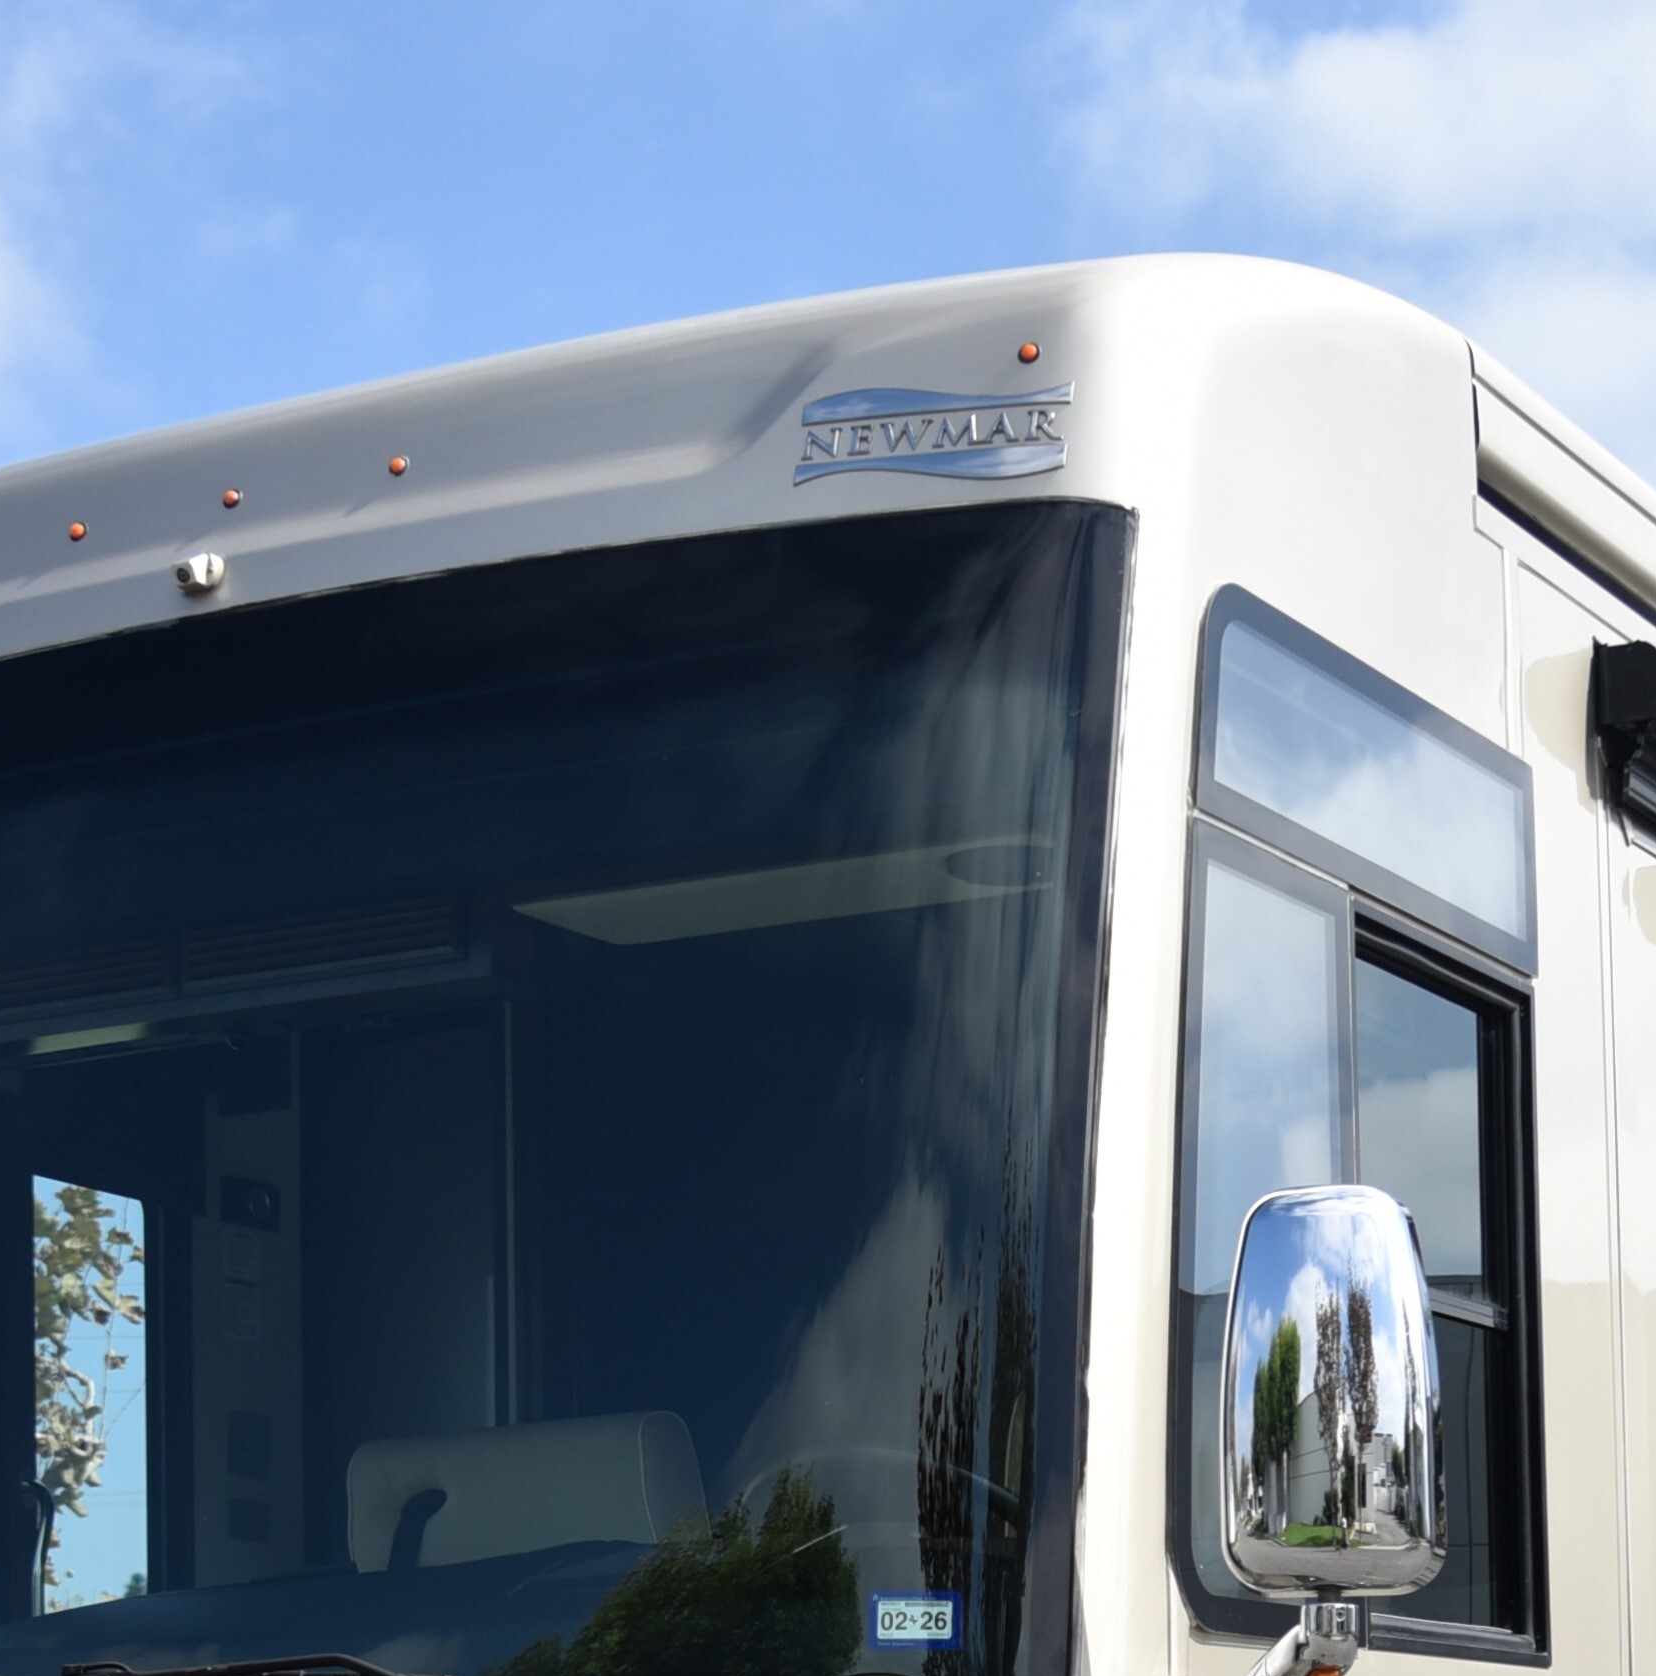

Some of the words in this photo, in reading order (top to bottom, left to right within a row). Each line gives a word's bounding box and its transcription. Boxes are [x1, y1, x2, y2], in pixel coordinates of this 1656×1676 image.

[800, 408, 1065, 462] NEWMAR
[880, 1611, 908, 1631] 02
[920, 1611, 948, 1631] 26
